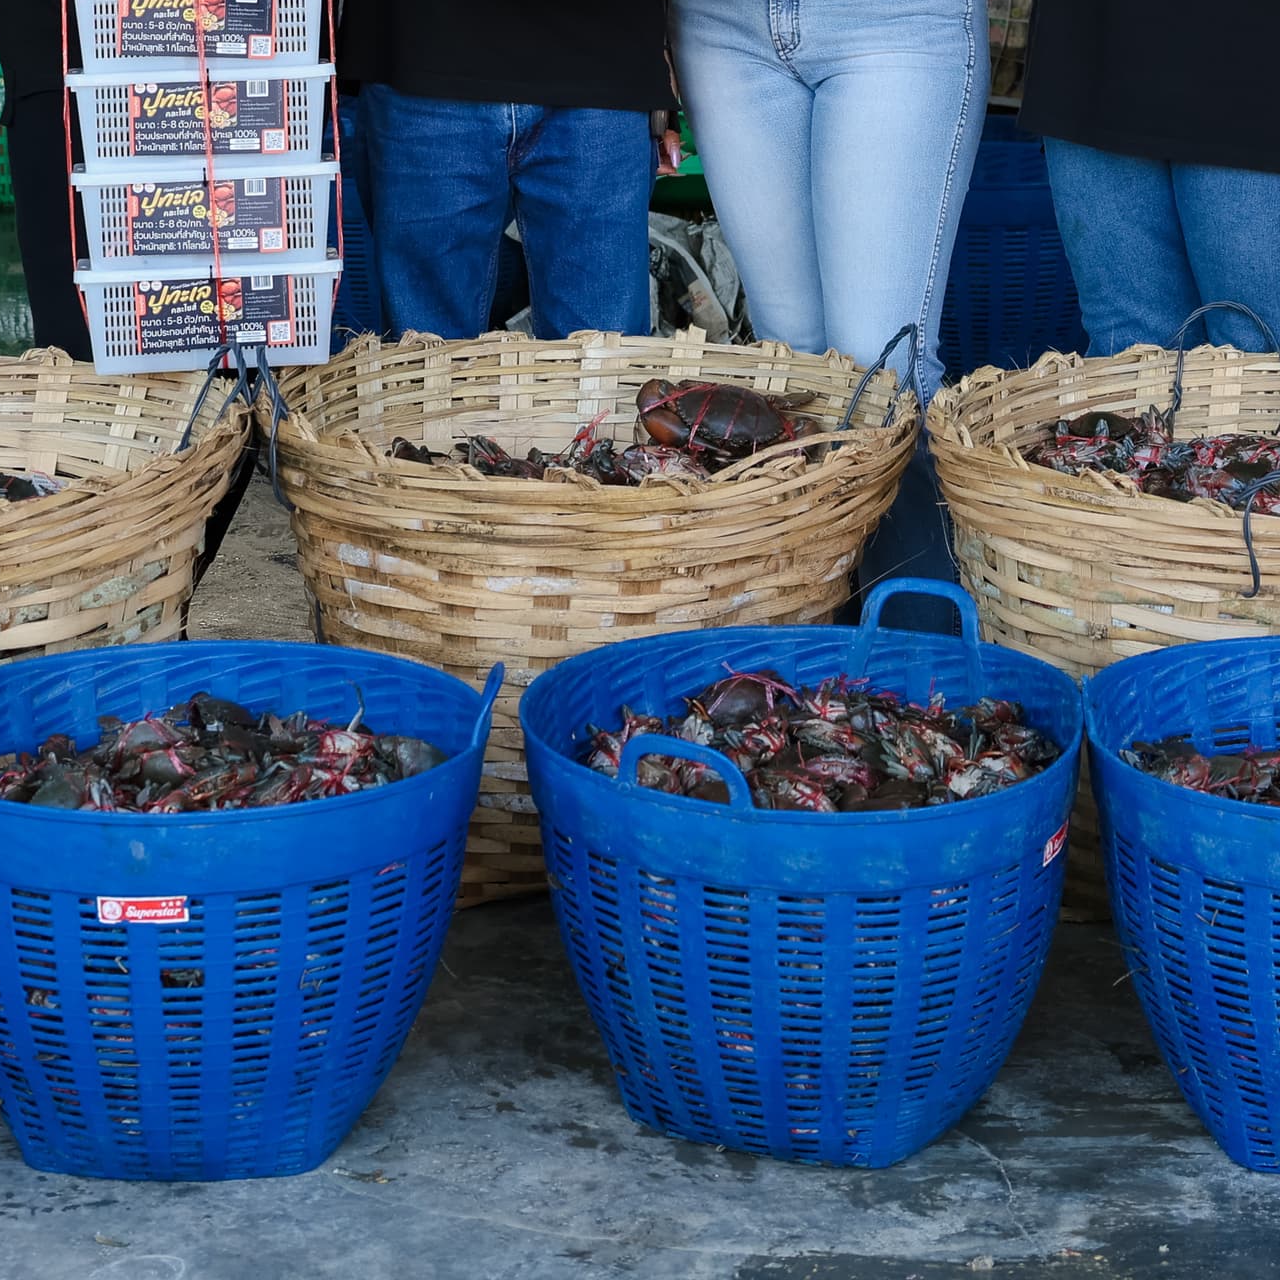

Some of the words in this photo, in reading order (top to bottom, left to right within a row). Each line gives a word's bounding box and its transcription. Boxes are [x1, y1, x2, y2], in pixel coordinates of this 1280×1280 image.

[222, 34, 244, 42] 100%
[233, 229, 255, 237] 100%
[126, 905, 181, 920] Superstar
